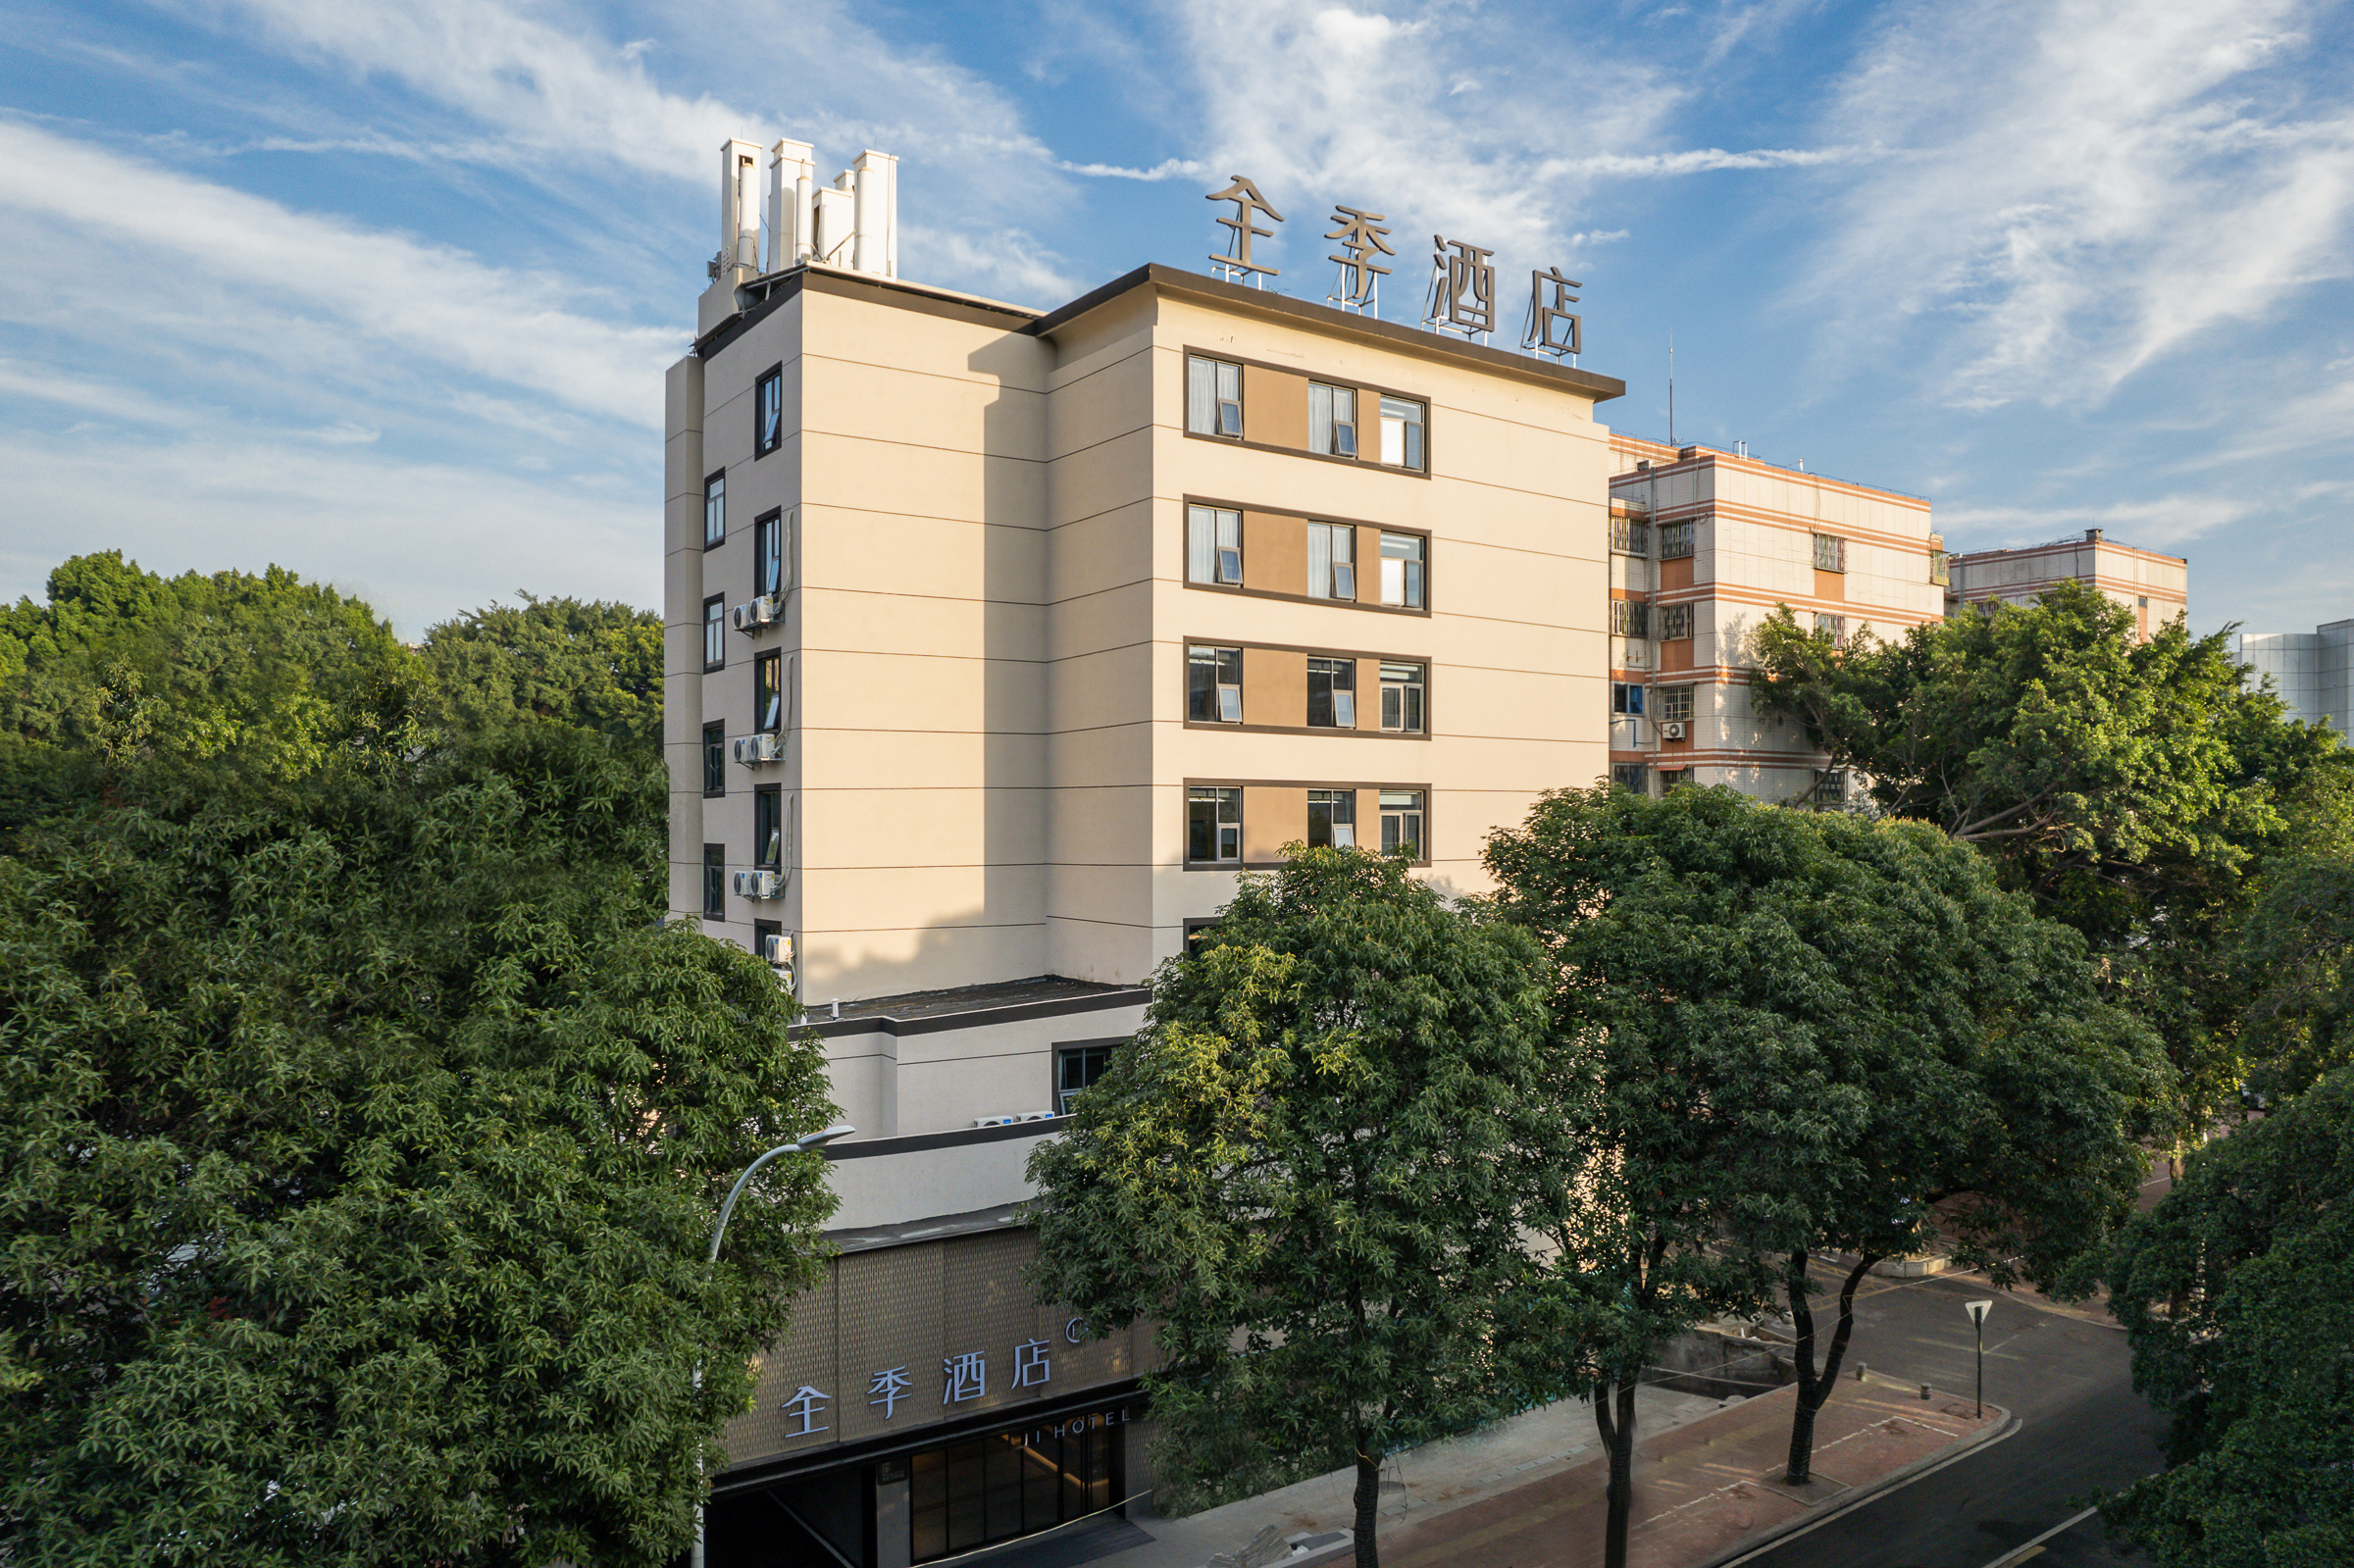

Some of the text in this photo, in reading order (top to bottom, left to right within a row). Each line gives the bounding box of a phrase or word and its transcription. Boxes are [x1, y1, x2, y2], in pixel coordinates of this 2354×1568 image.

[1205, 175, 1582, 354] 全季酒店
[782, 1339, 1050, 1438] 全季酒店
[1024, 1409, 1131, 1446] JI HOTEL
